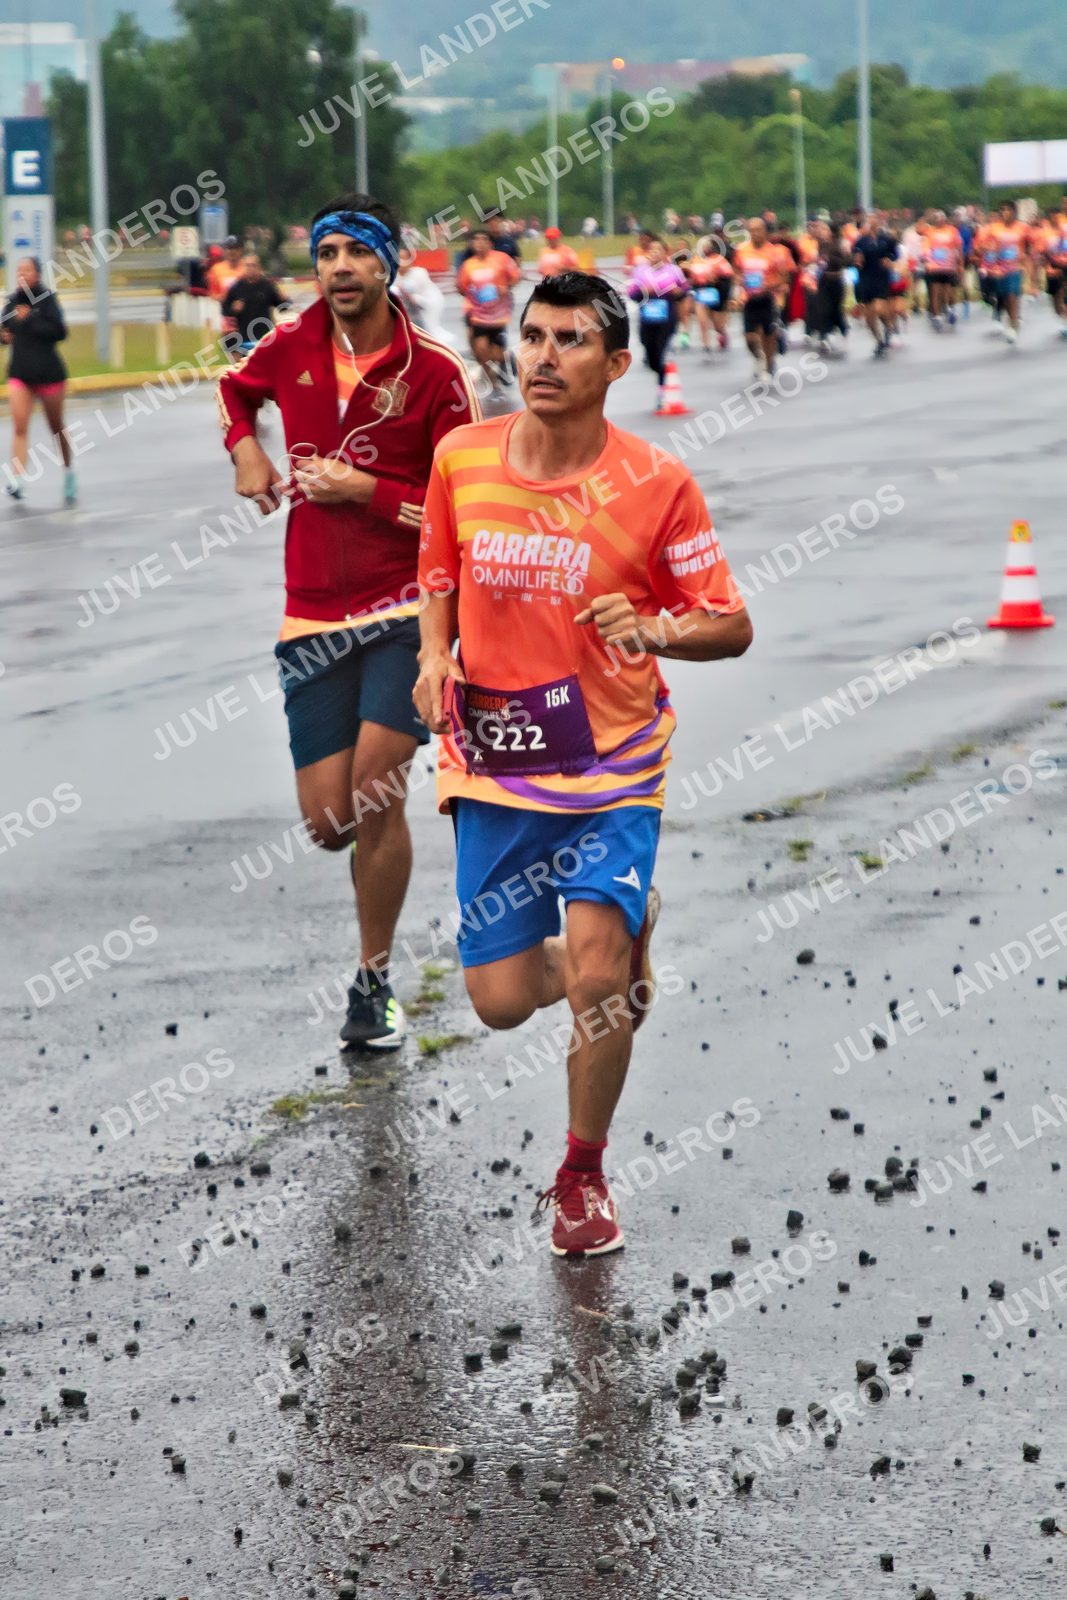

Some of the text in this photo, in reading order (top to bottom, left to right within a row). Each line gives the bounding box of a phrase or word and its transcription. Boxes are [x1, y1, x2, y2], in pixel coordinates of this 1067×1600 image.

[12, 150, 41, 187] E
[472, 529, 592, 573] CARRERA
[472, 565, 561, 592] OMNILIFE
[545, 685, 570, 708] 15K
[489, 725, 546, 751] 222
